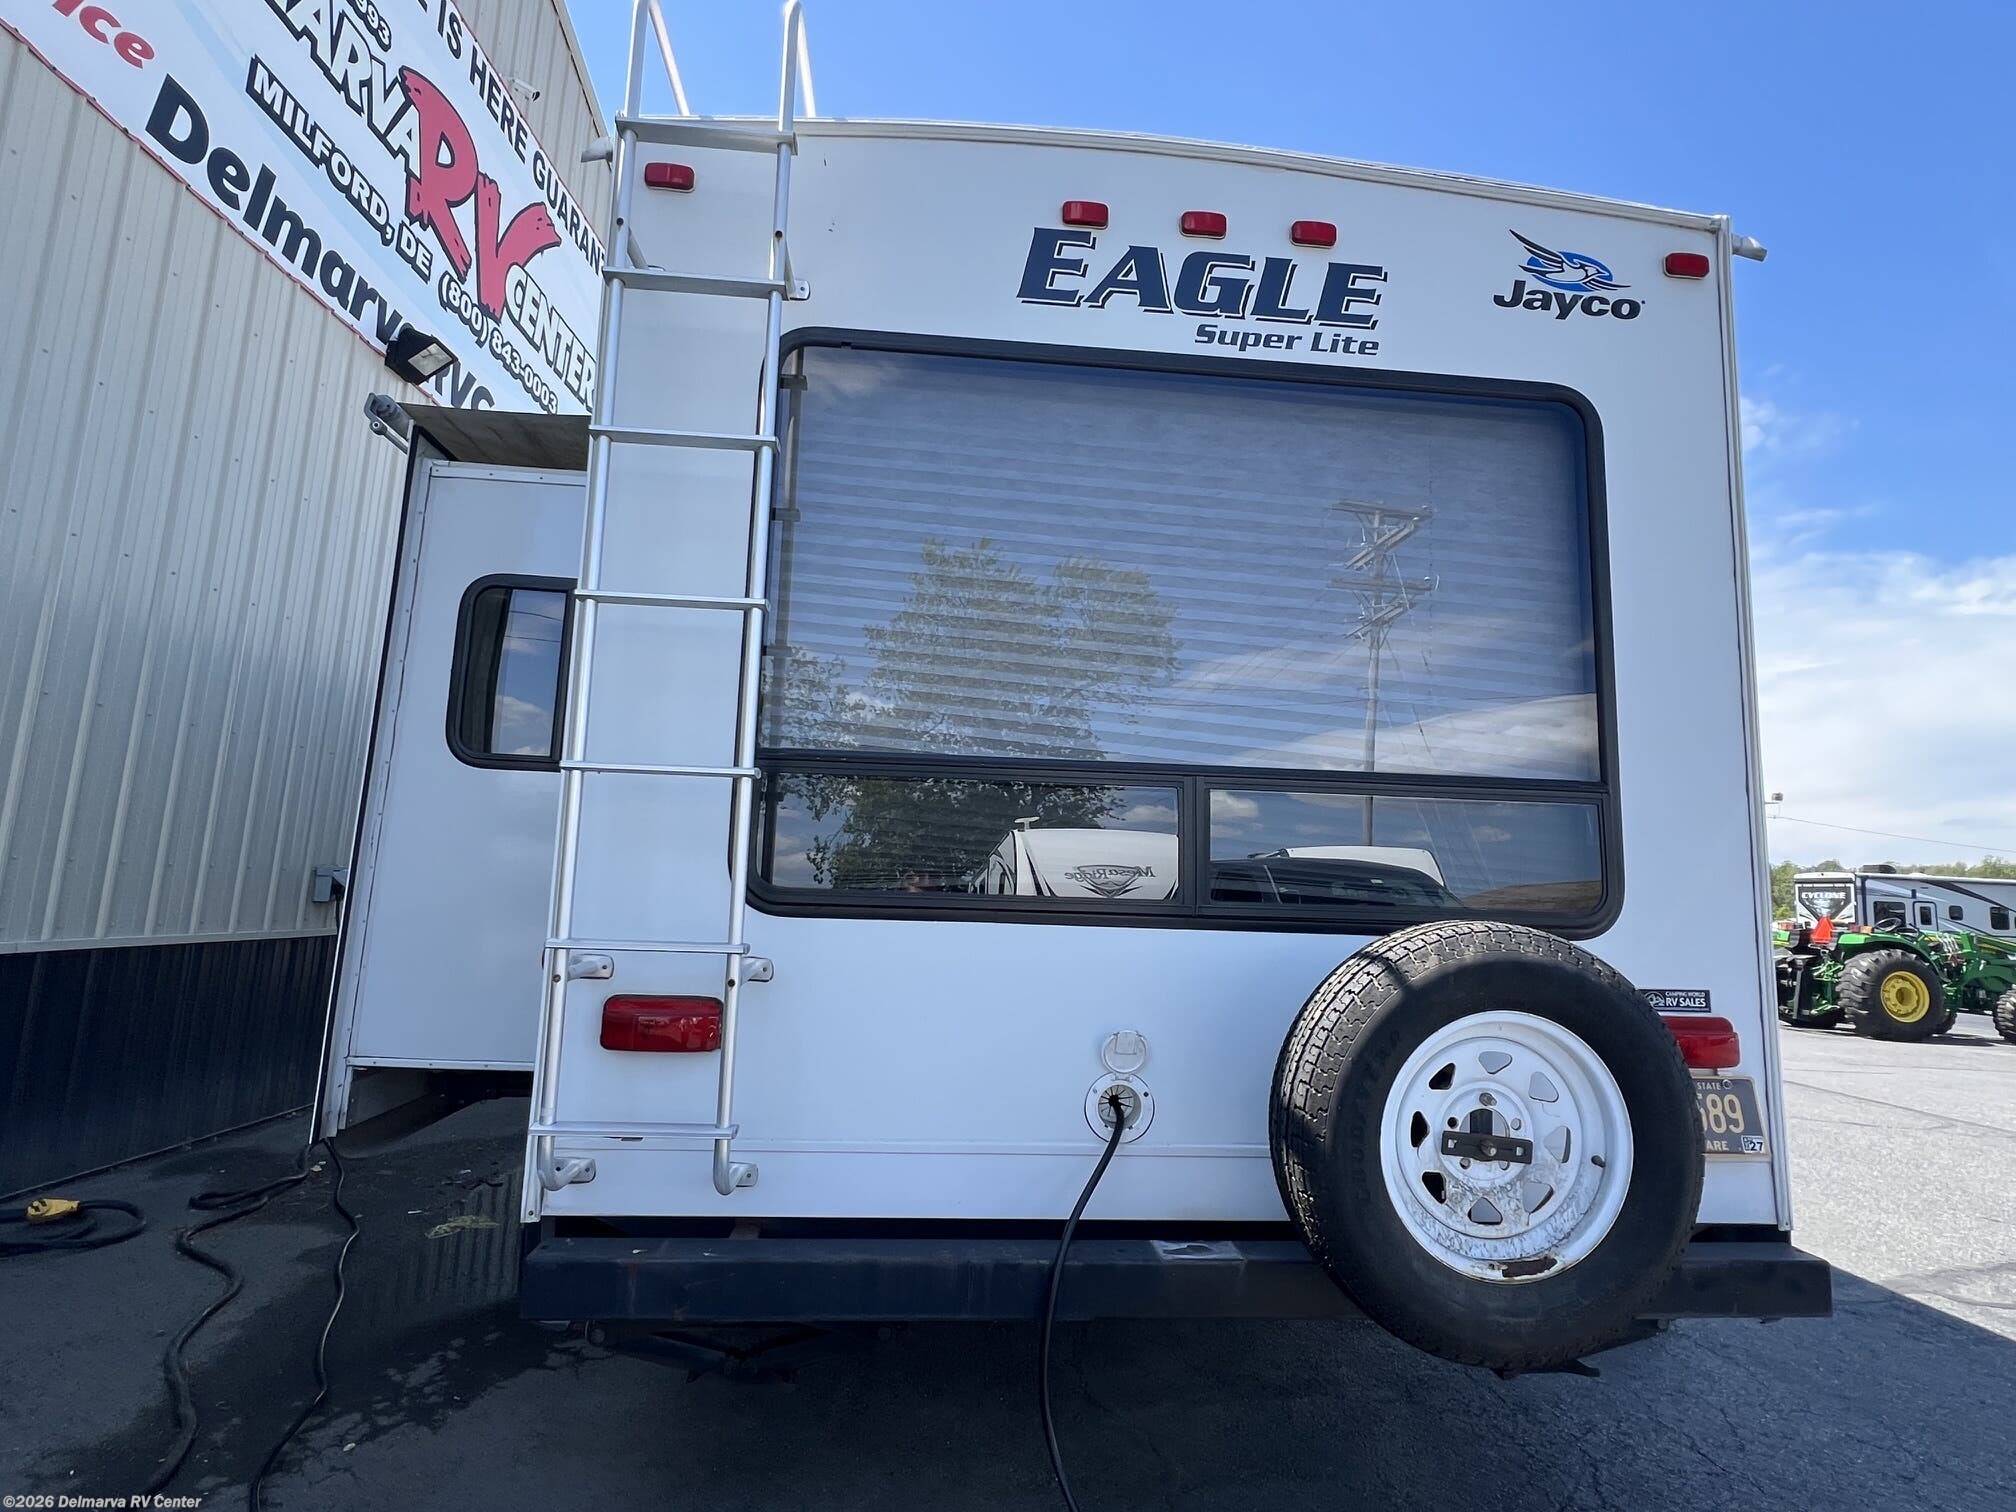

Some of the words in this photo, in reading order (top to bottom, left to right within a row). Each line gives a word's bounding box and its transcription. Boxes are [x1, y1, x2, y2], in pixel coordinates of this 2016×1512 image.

[437, 0, 463, 59] IS
[470, 46, 528, 165] HERE
[532, 150, 607, 282] GUARAN
[264, 0, 423, 184] ARVA
[504, 261, 598, 415] CENTER
[246, 54, 395, 247] MILFORD,
[395, 220, 433, 285] DE
[438, 270, 490, 349] (800)
[488, 326, 560, 415] 843-0003
[1016, 227, 1388, 330] EAGLE
[1493, 279, 1641, 320] Jayco
[1195, 323, 1303, 352] Super
[1310, 331, 1380, 356] Lite
[1665, 997, 1678, 1007] RV
[1679, 997, 1706, 1008] SALES
[1696, 1081, 1721, 1091] STATE
[1750, 1141, 1764, 1152] 27
